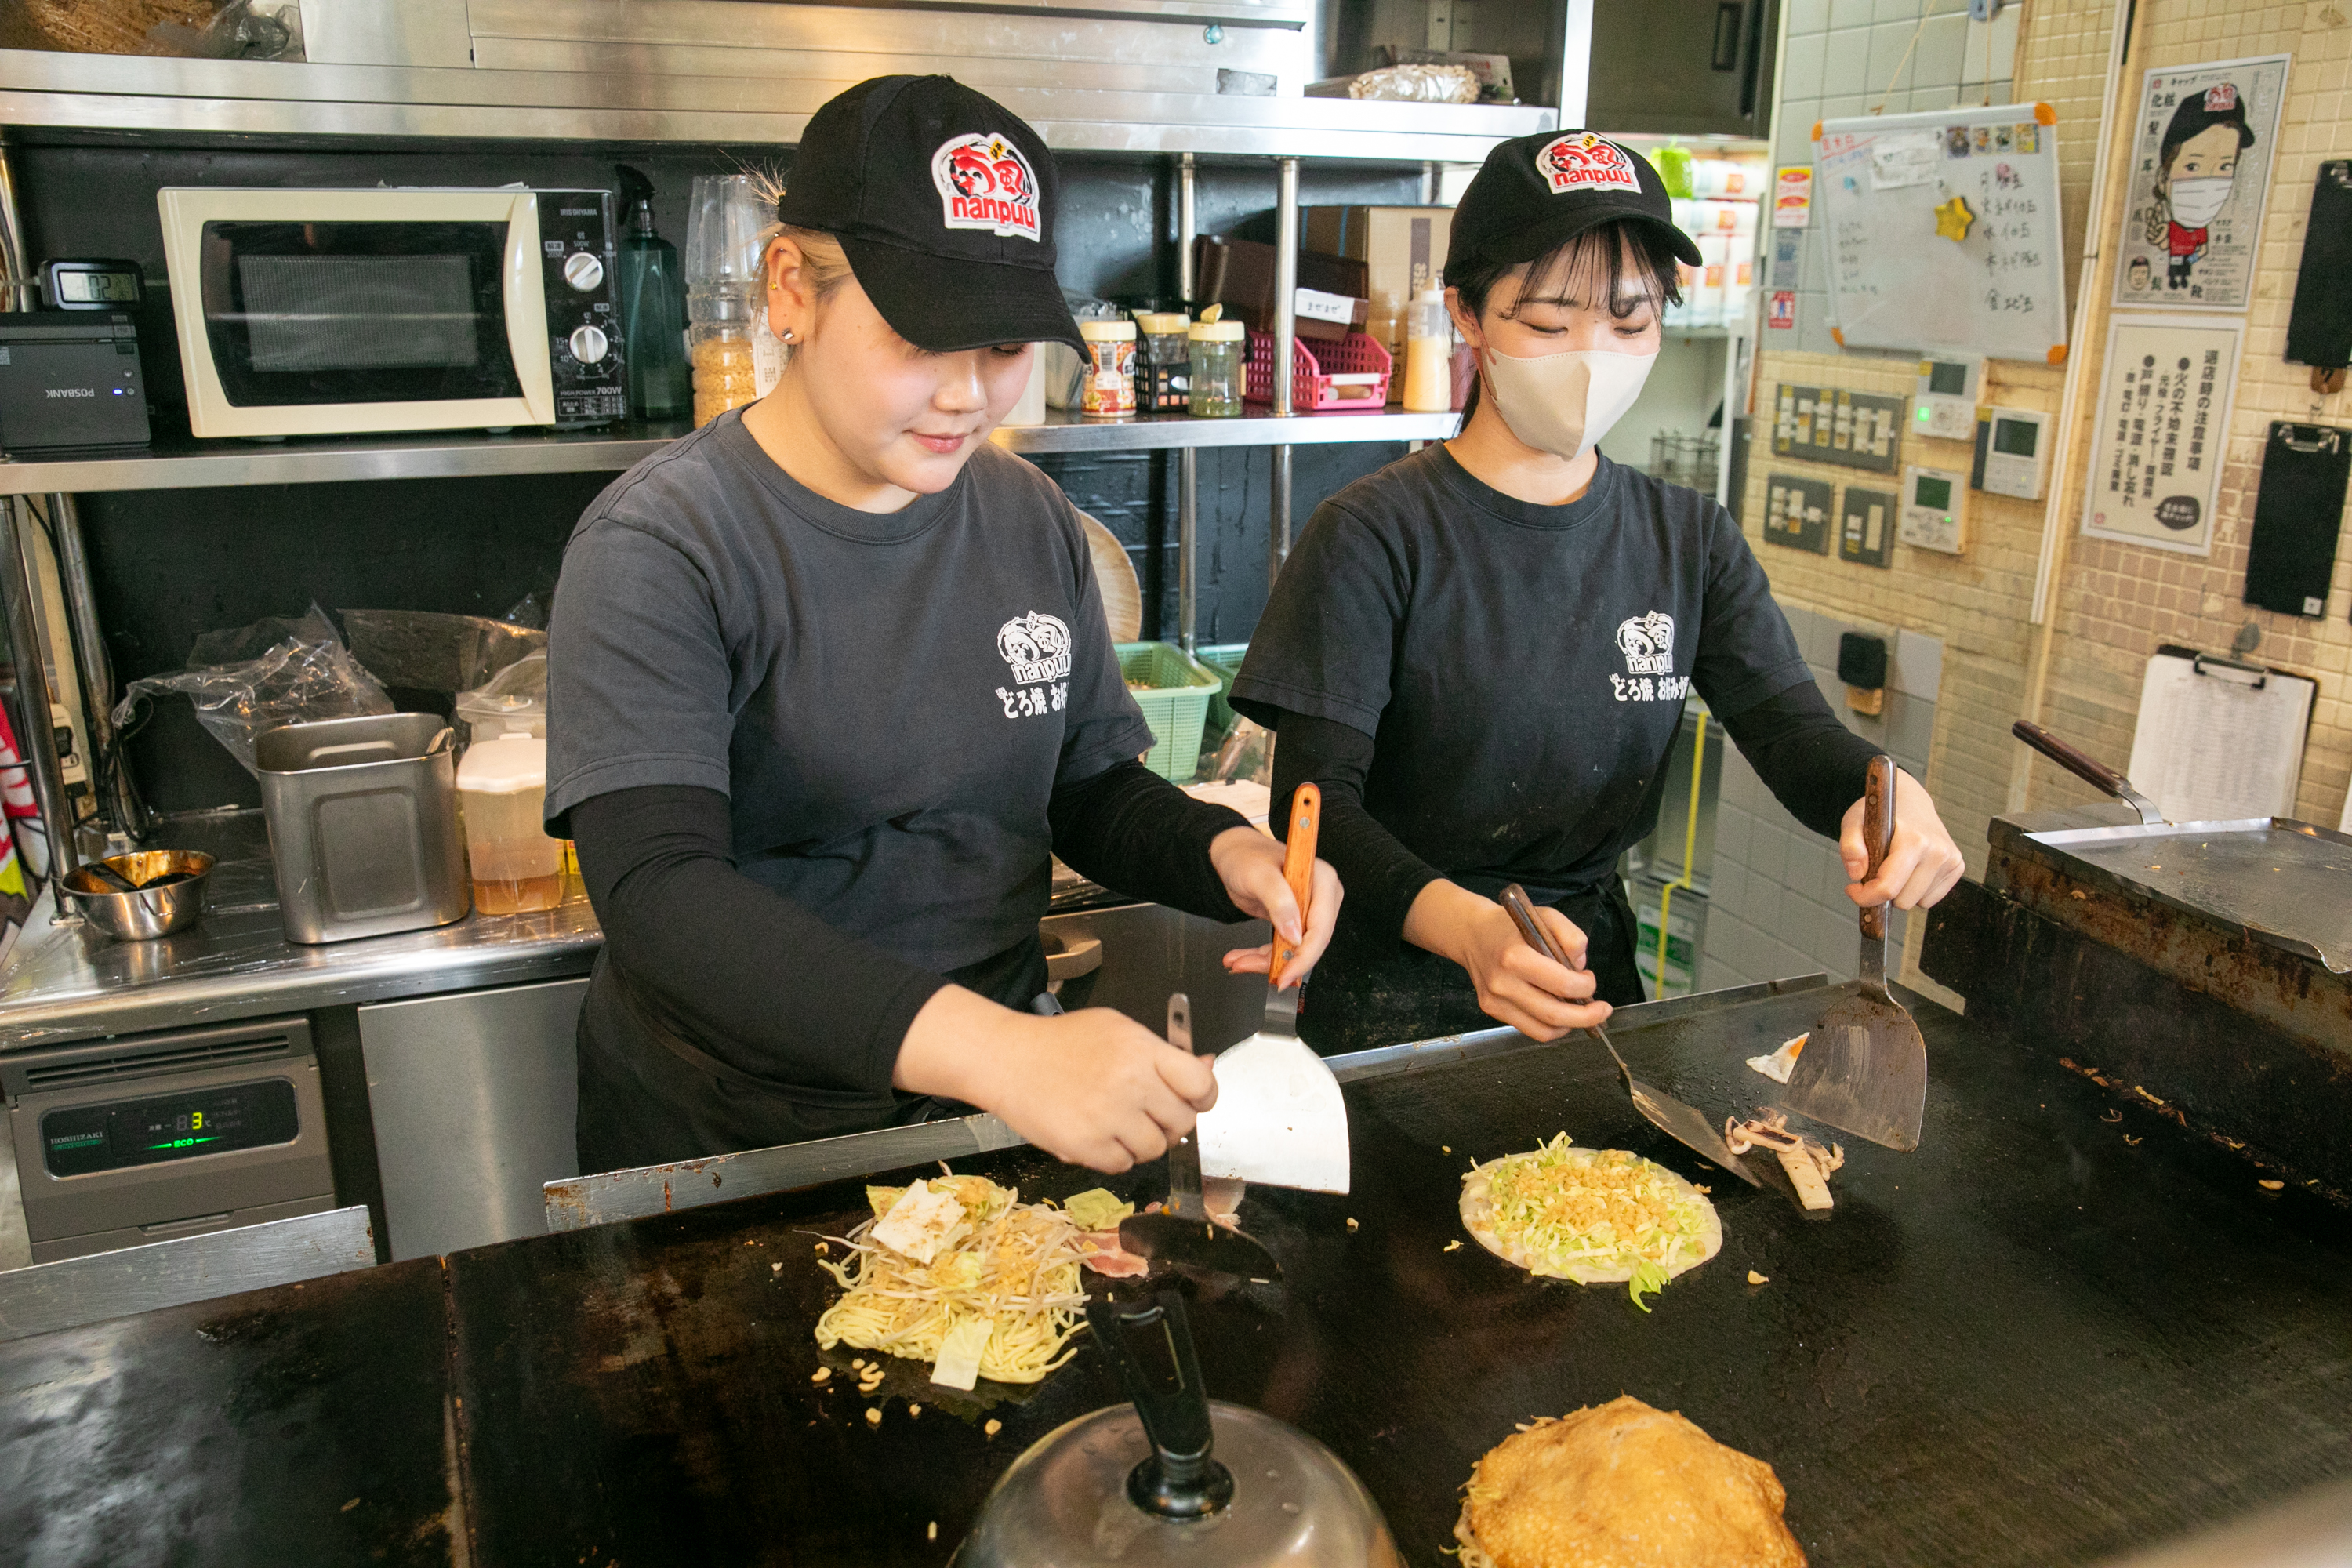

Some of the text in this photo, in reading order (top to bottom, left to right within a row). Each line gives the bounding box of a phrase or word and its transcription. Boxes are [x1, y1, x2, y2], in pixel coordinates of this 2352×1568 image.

[1554, 169, 1632, 187] nanpuu
[951, 196, 1036, 230] nanpuu
[45, 387, 95, 399] POSBANK
[596, 386, 622, 395] 700W
[1013, 655, 1071, 682] nanpuu
[1613, 677, 1655, 702] どろ焼
[1004, 687, 1048, 719] どろ焼
[50, 1131, 104, 1145] HOSHIZAKI
[173, 1138, 194, 1149] ECO
